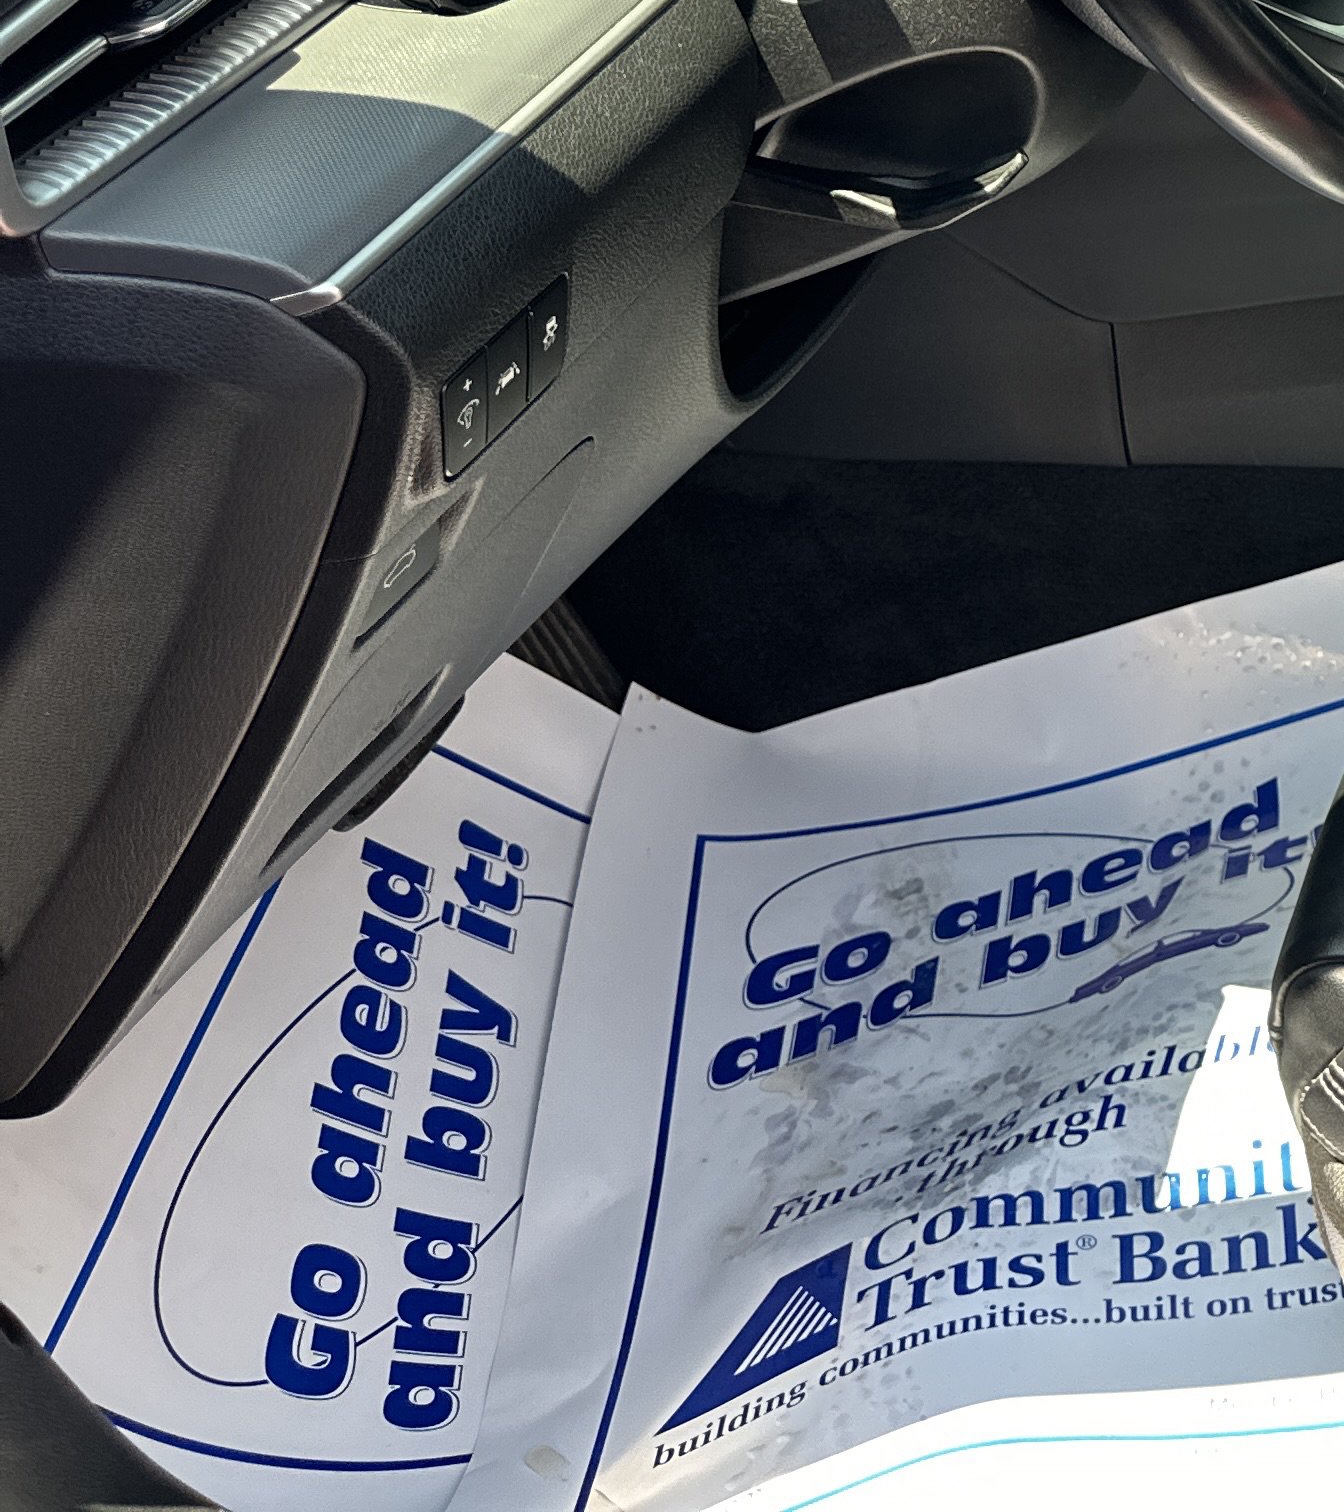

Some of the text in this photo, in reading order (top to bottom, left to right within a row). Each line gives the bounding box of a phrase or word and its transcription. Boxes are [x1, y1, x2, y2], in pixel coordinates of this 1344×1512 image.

[744, 777, 1281, 1011] Go ahead
[707, 956, 938, 1088] and
[977, 876, 1186, 990] buy
[265, 837, 437, 1402] Go ahead
[383, 818, 529, 1433] and buy it!
[761, 1111, 1019, 1236] Financing
[864, 1136, 1314, 1272] Communit
[917, 1095, 1127, 1195] through
[1112, 1197, 1329, 1285] Bank
[652, 1383, 807, 1469] building
[1206, 1295, 1253, 1319] on
